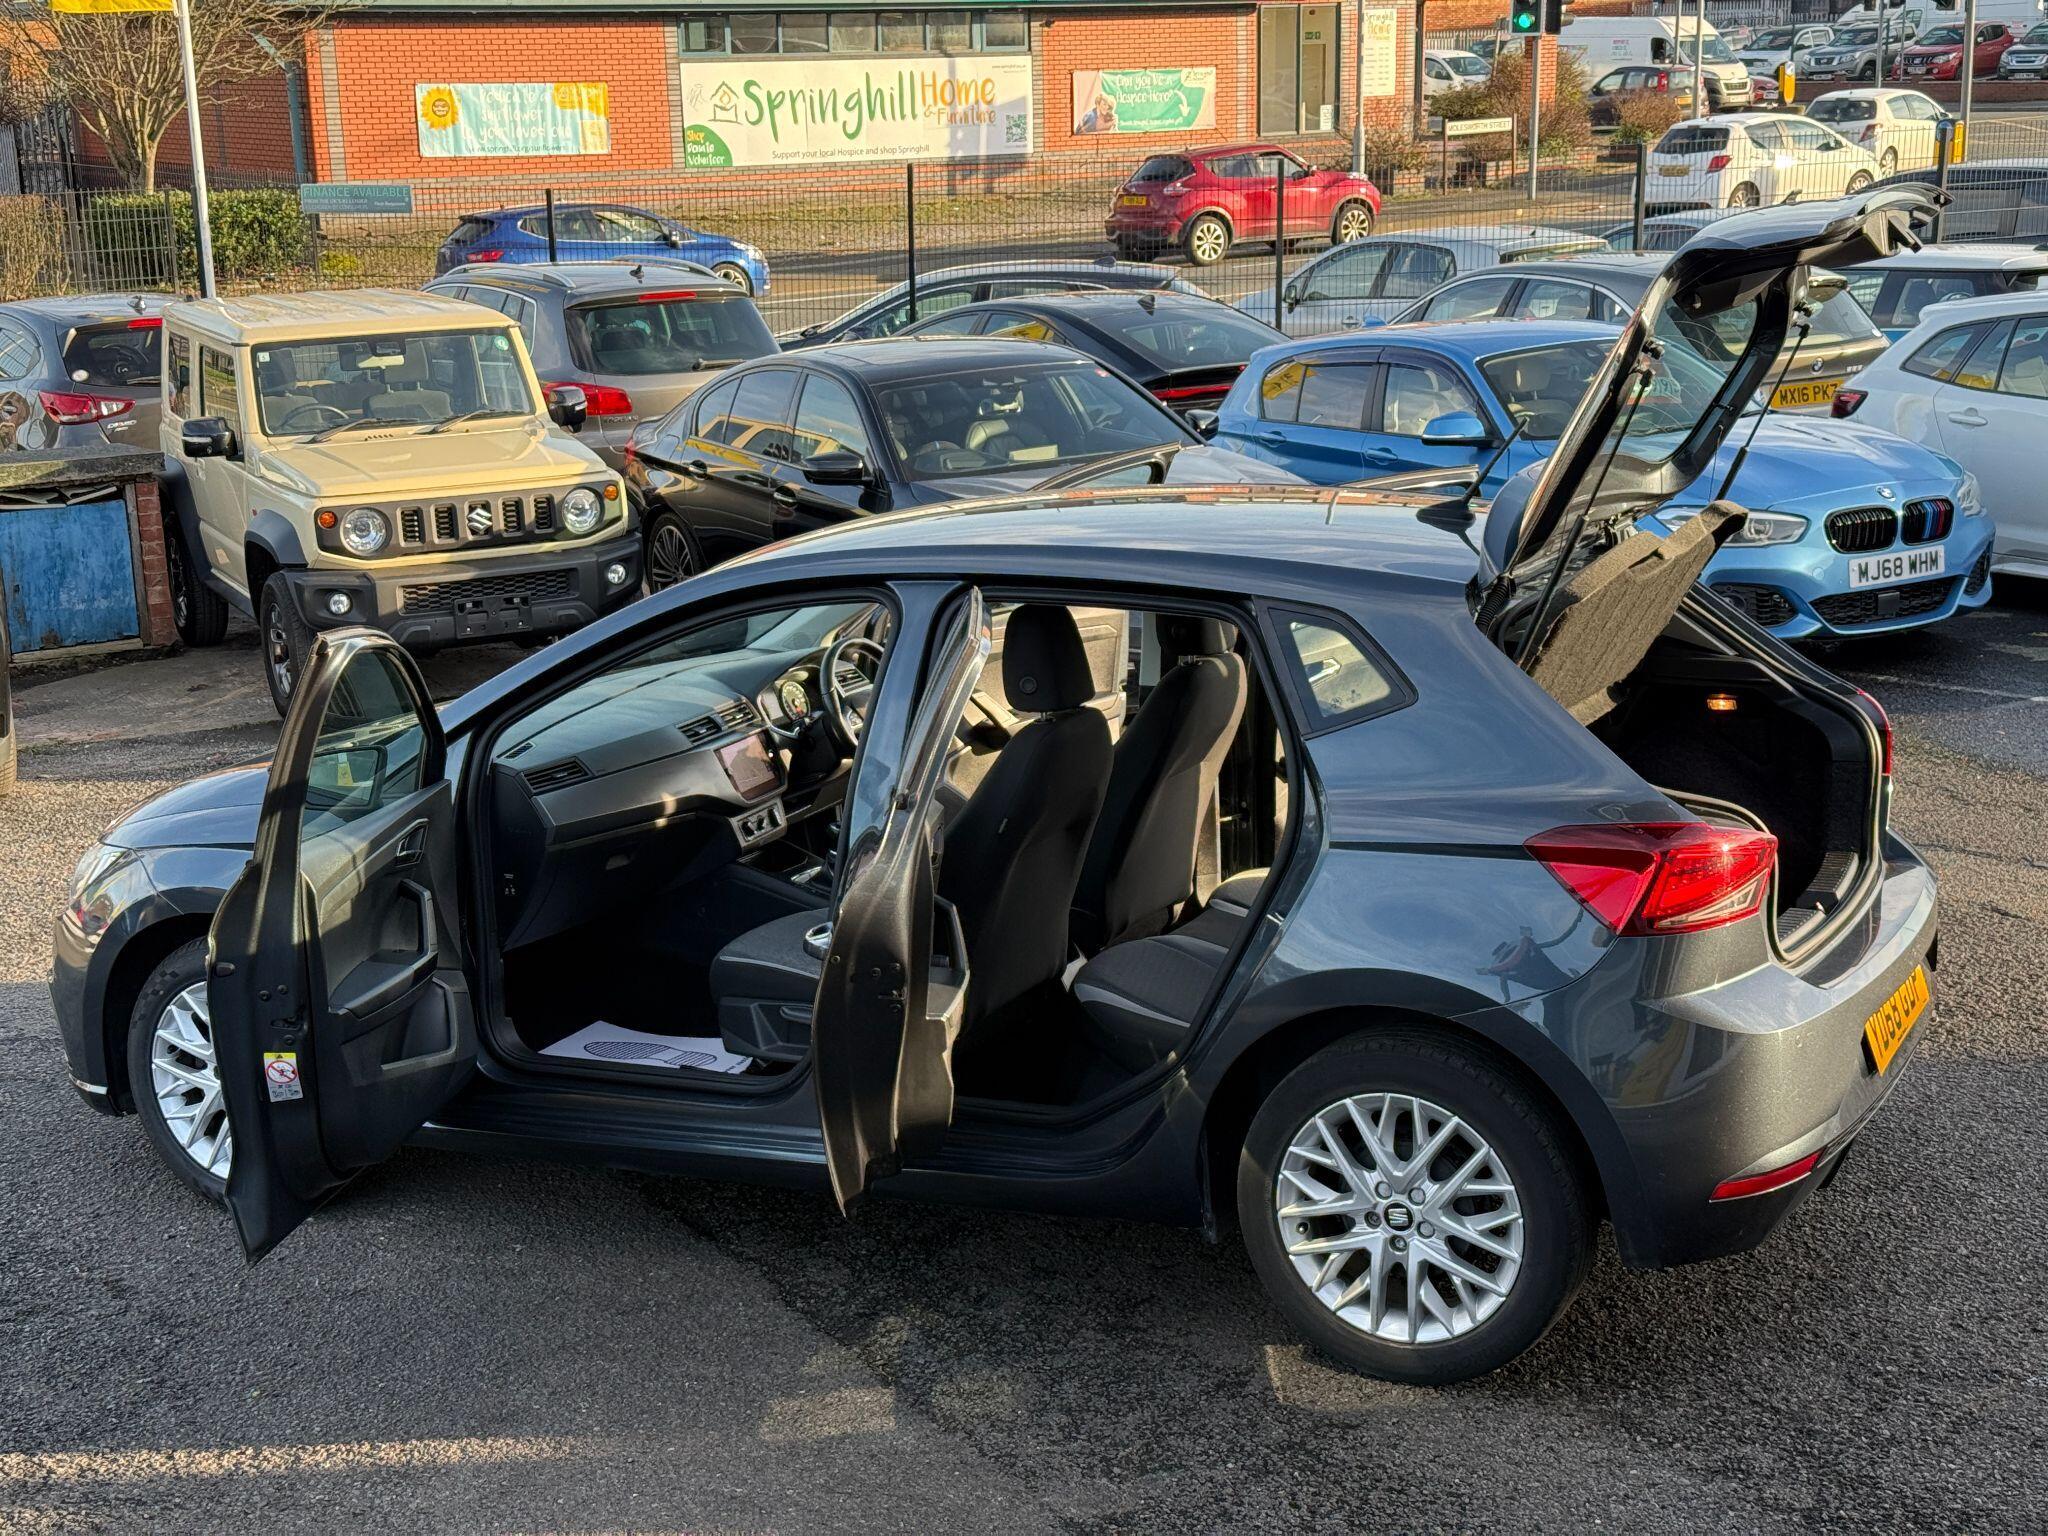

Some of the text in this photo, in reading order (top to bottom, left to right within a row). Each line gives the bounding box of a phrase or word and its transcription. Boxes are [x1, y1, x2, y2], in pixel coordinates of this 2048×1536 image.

[480, 107, 544, 122] sunflower
[743, 70, 996, 144] Springhill Home
[937, 105, 997, 125] Furniture
[1489, 120, 1510, 129] STREET
[687, 130, 705, 144] Shop
[687, 141, 715, 154] Donate
[772, 144, 930, 160] Support your local Hospice and shop Springhill
[688, 153, 726, 166] Volunteer
[303, 187, 408, 197] FINANCE AVAILABLE
[1780, 386, 1809, 405] MX16
[1858, 550, 1939, 583] MJ68 WHM
